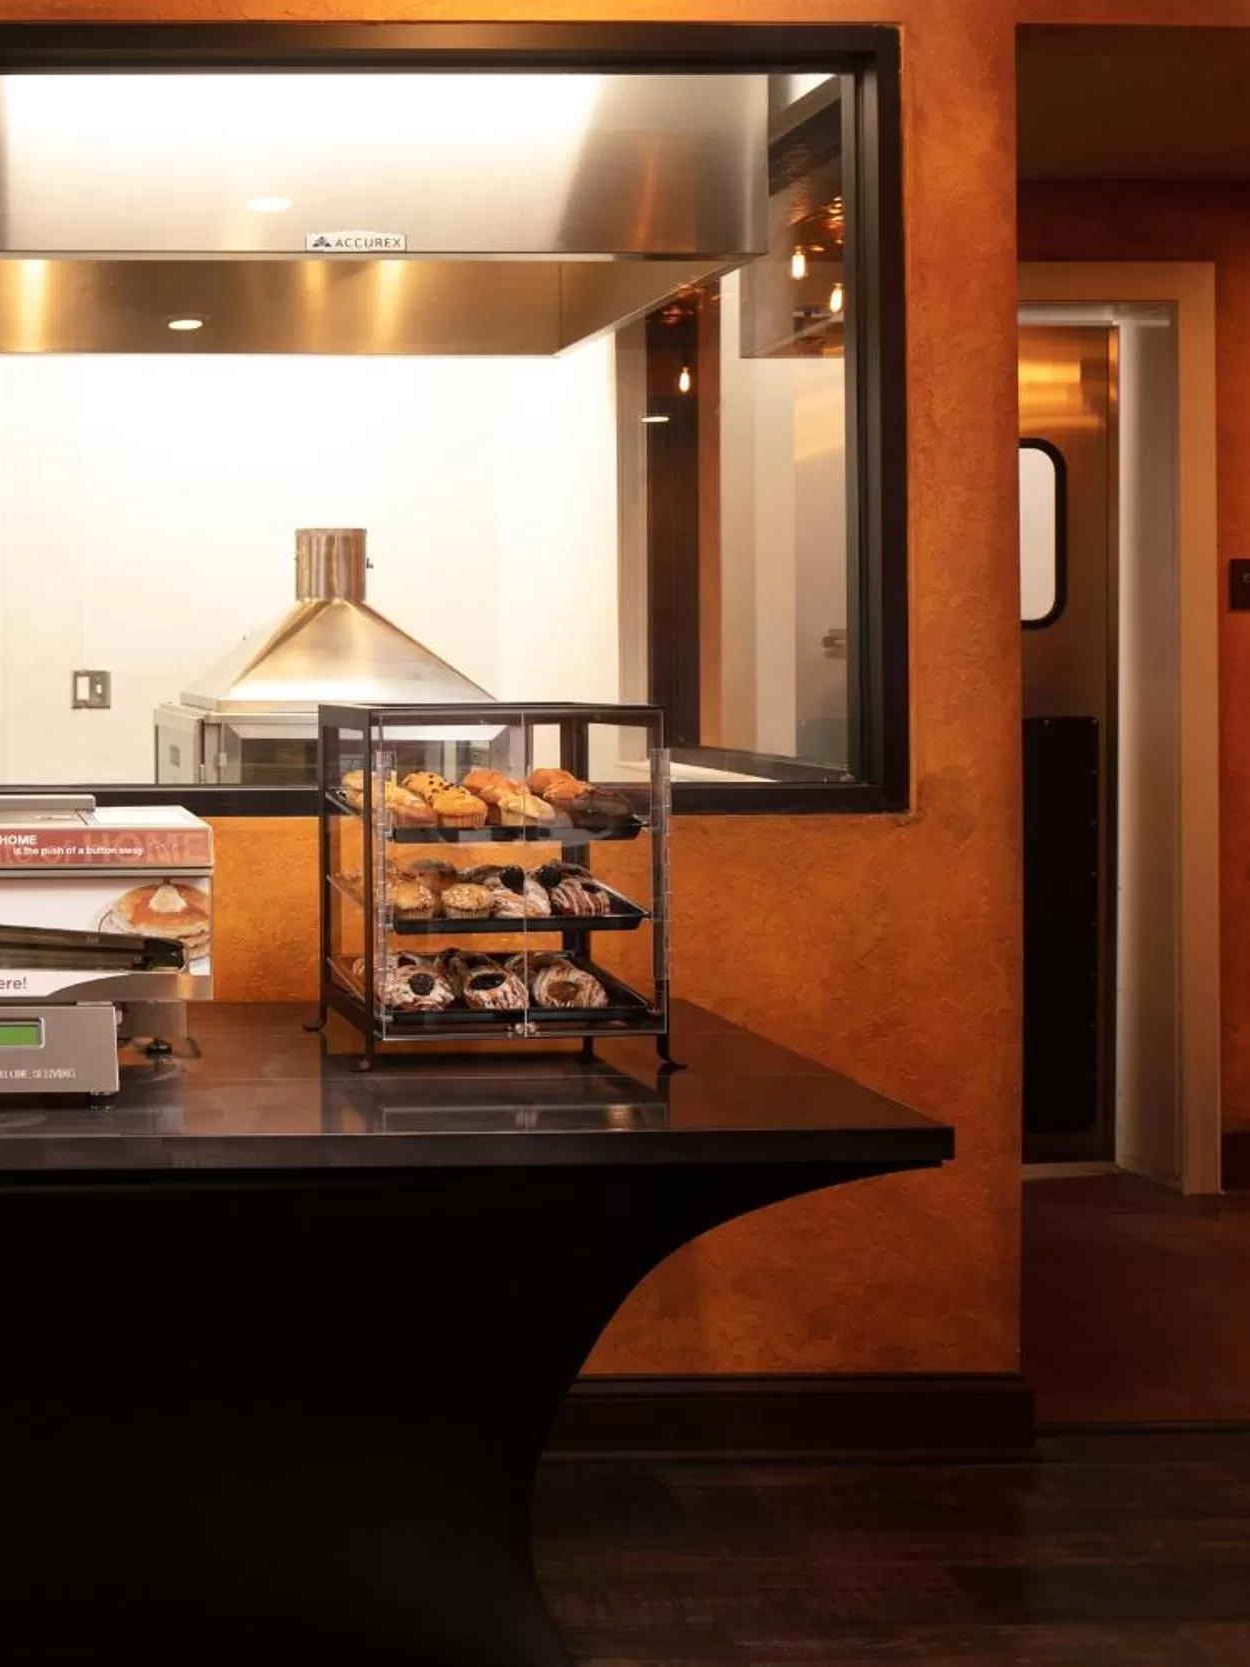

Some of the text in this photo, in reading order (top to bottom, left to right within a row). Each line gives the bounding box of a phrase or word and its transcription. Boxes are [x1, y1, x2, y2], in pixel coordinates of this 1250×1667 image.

[335, 237, 401, 248] ACCUREX
[24, 846, 39, 856] the
[41, 847, 64, 858] push
[66, 846, 76, 855] of
[86, 846, 117, 855] button
